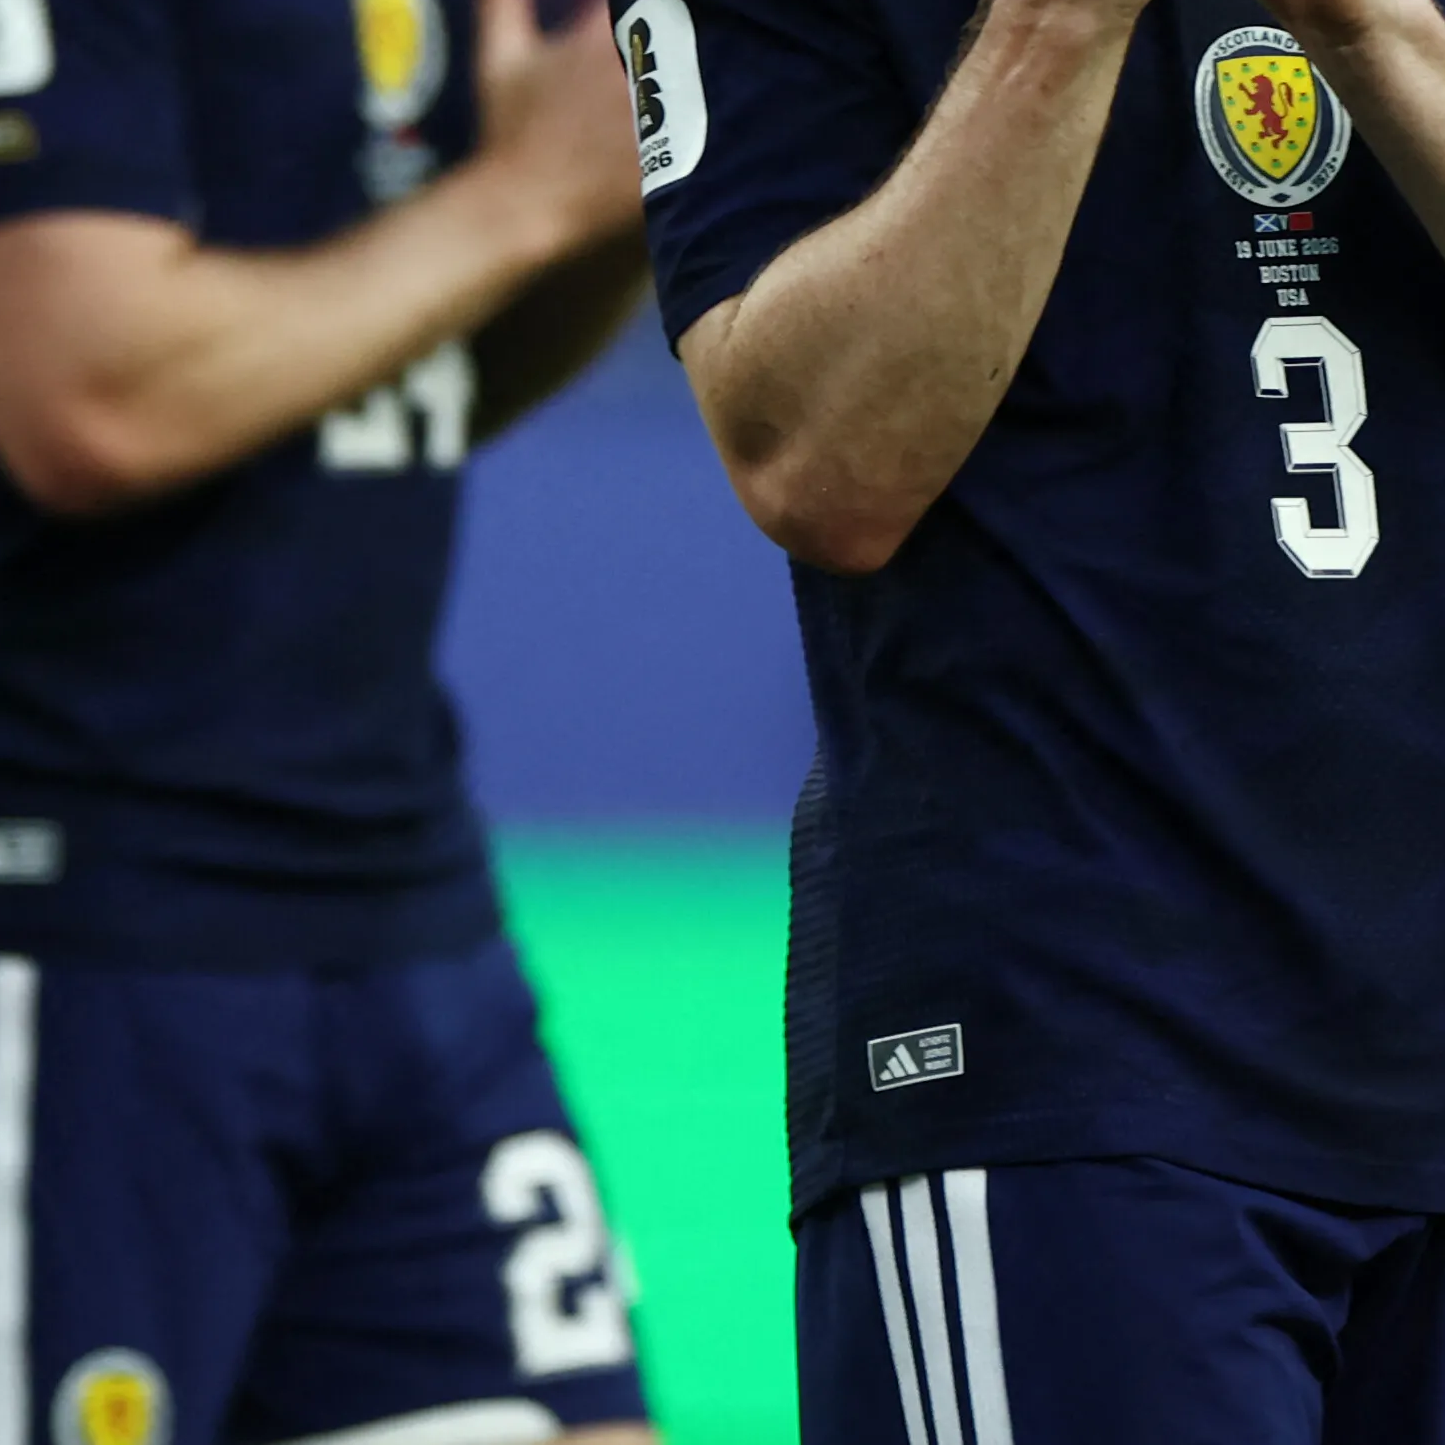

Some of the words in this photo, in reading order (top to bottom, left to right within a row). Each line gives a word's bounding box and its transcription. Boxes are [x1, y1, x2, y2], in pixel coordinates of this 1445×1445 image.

[1217, 30, 1296, 54] SCOTLAND
[1224, 166, 1246, 191] EST
[1313, 161, 1337, 189] 1873
[1234, 240, 1253, 259] 19
[1255, 238, 1299, 258] JUNE
[1300, 236, 1340, 256] 2026
[1258, 263, 1321, 284] BOSTON
[1276, 287, 1310, 307] USA
[1249, 315, 1380, 580] 3
[477, 1127, 640, 1377] 2
